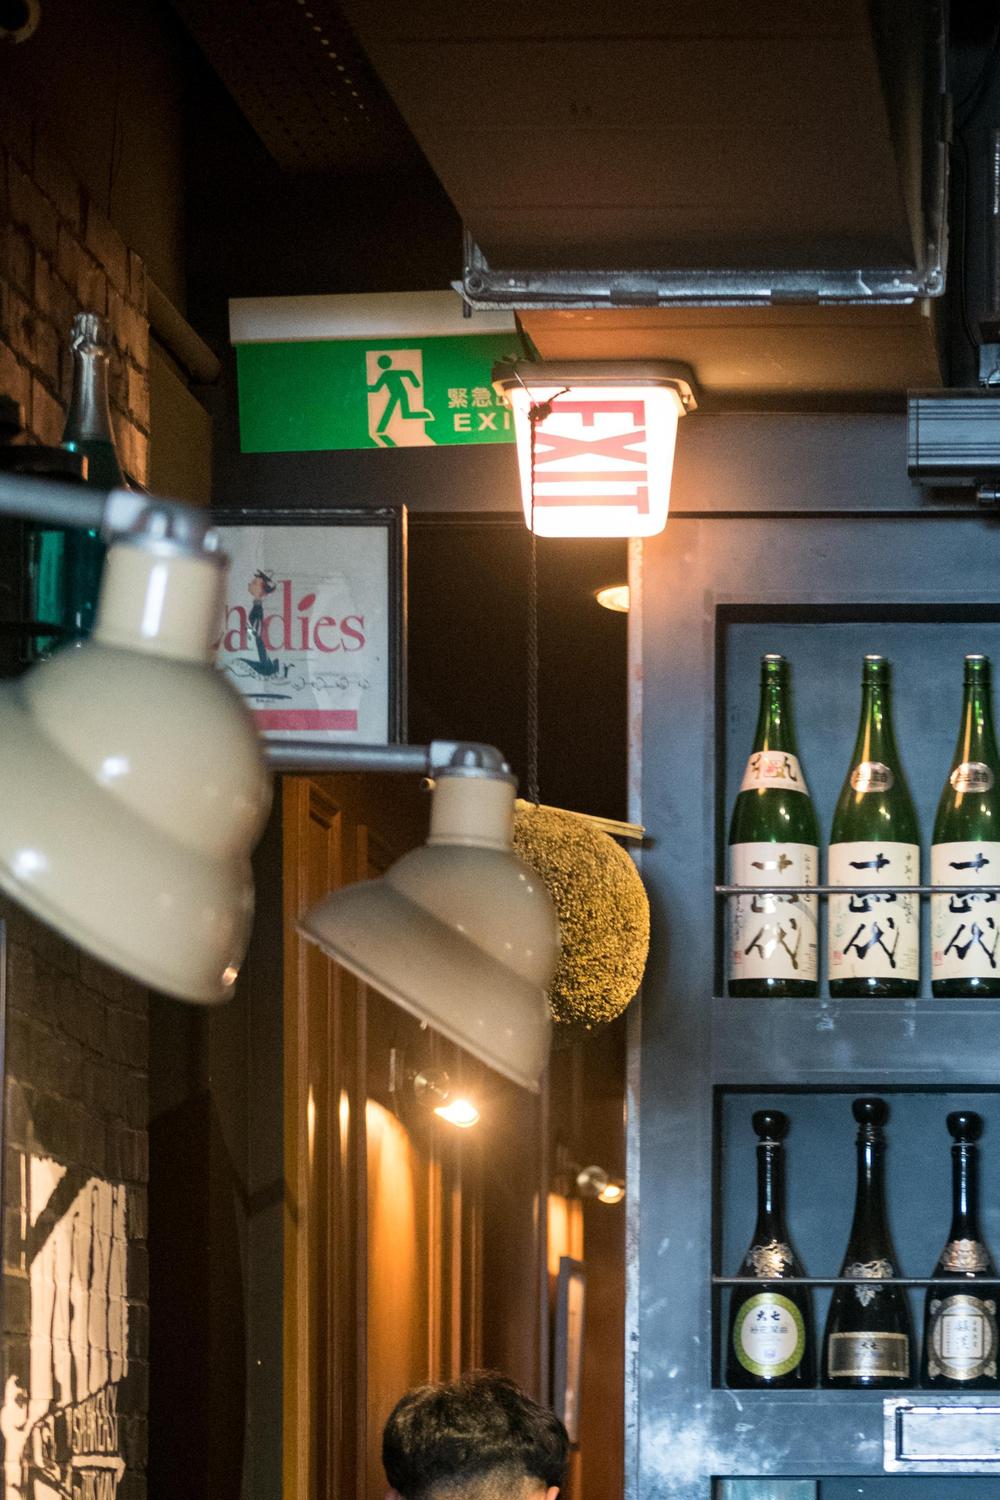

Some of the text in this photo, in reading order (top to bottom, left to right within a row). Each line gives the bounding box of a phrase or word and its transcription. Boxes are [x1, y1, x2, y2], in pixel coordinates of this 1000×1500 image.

[453, 412, 510, 432] EXI
[530, 400, 650, 514] EXIT
[208, 579, 366, 653] adies
